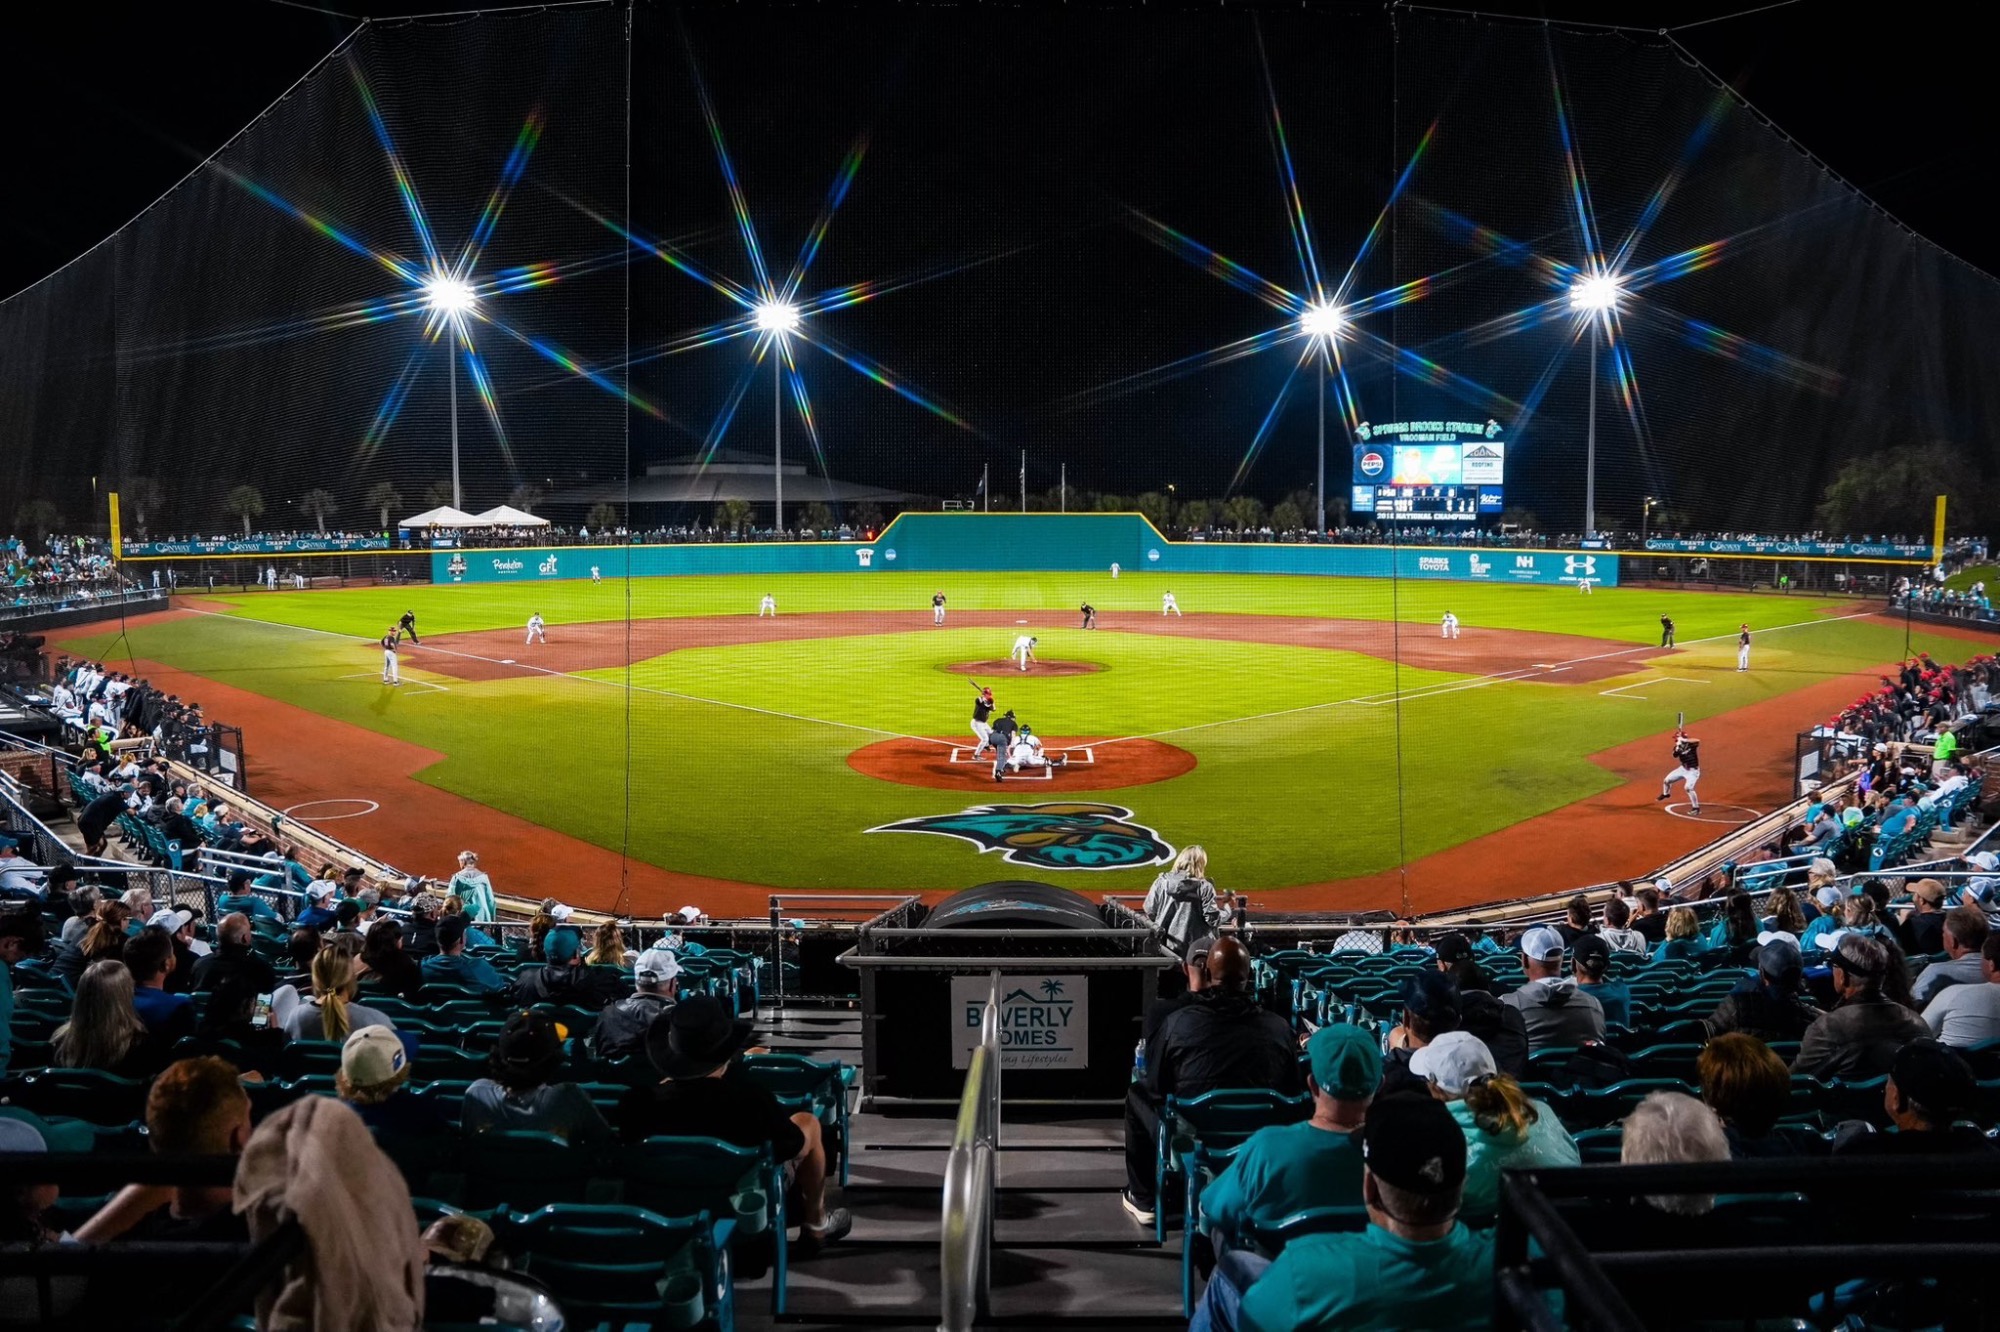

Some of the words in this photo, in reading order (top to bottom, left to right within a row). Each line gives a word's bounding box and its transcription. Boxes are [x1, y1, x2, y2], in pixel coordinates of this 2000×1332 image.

[1436, 433, 1456, 441] FIELD
[155, 542, 190, 553] CONWAY
[228, 541, 260, 551] CONWAY
[296, 540, 327, 550] CONWAY
[1645, 540, 1675, 550] CONWAY
[1710, 541, 1741, 551] CONWAY
[1776, 542, 1810, 553] CONWAY
[1850, 543, 1888, 555] CONWAY
[492, 558, 523, 570] Revolution
[539, 558, 557, 573] GFL
[1419, 563, 1449, 571] TOYOTA
[966, 1007, 1073, 1027] BVERLY
[1000, 1030, 1057, 1045] OMES
[1021, 1053, 1067, 1068] Lifestyles
